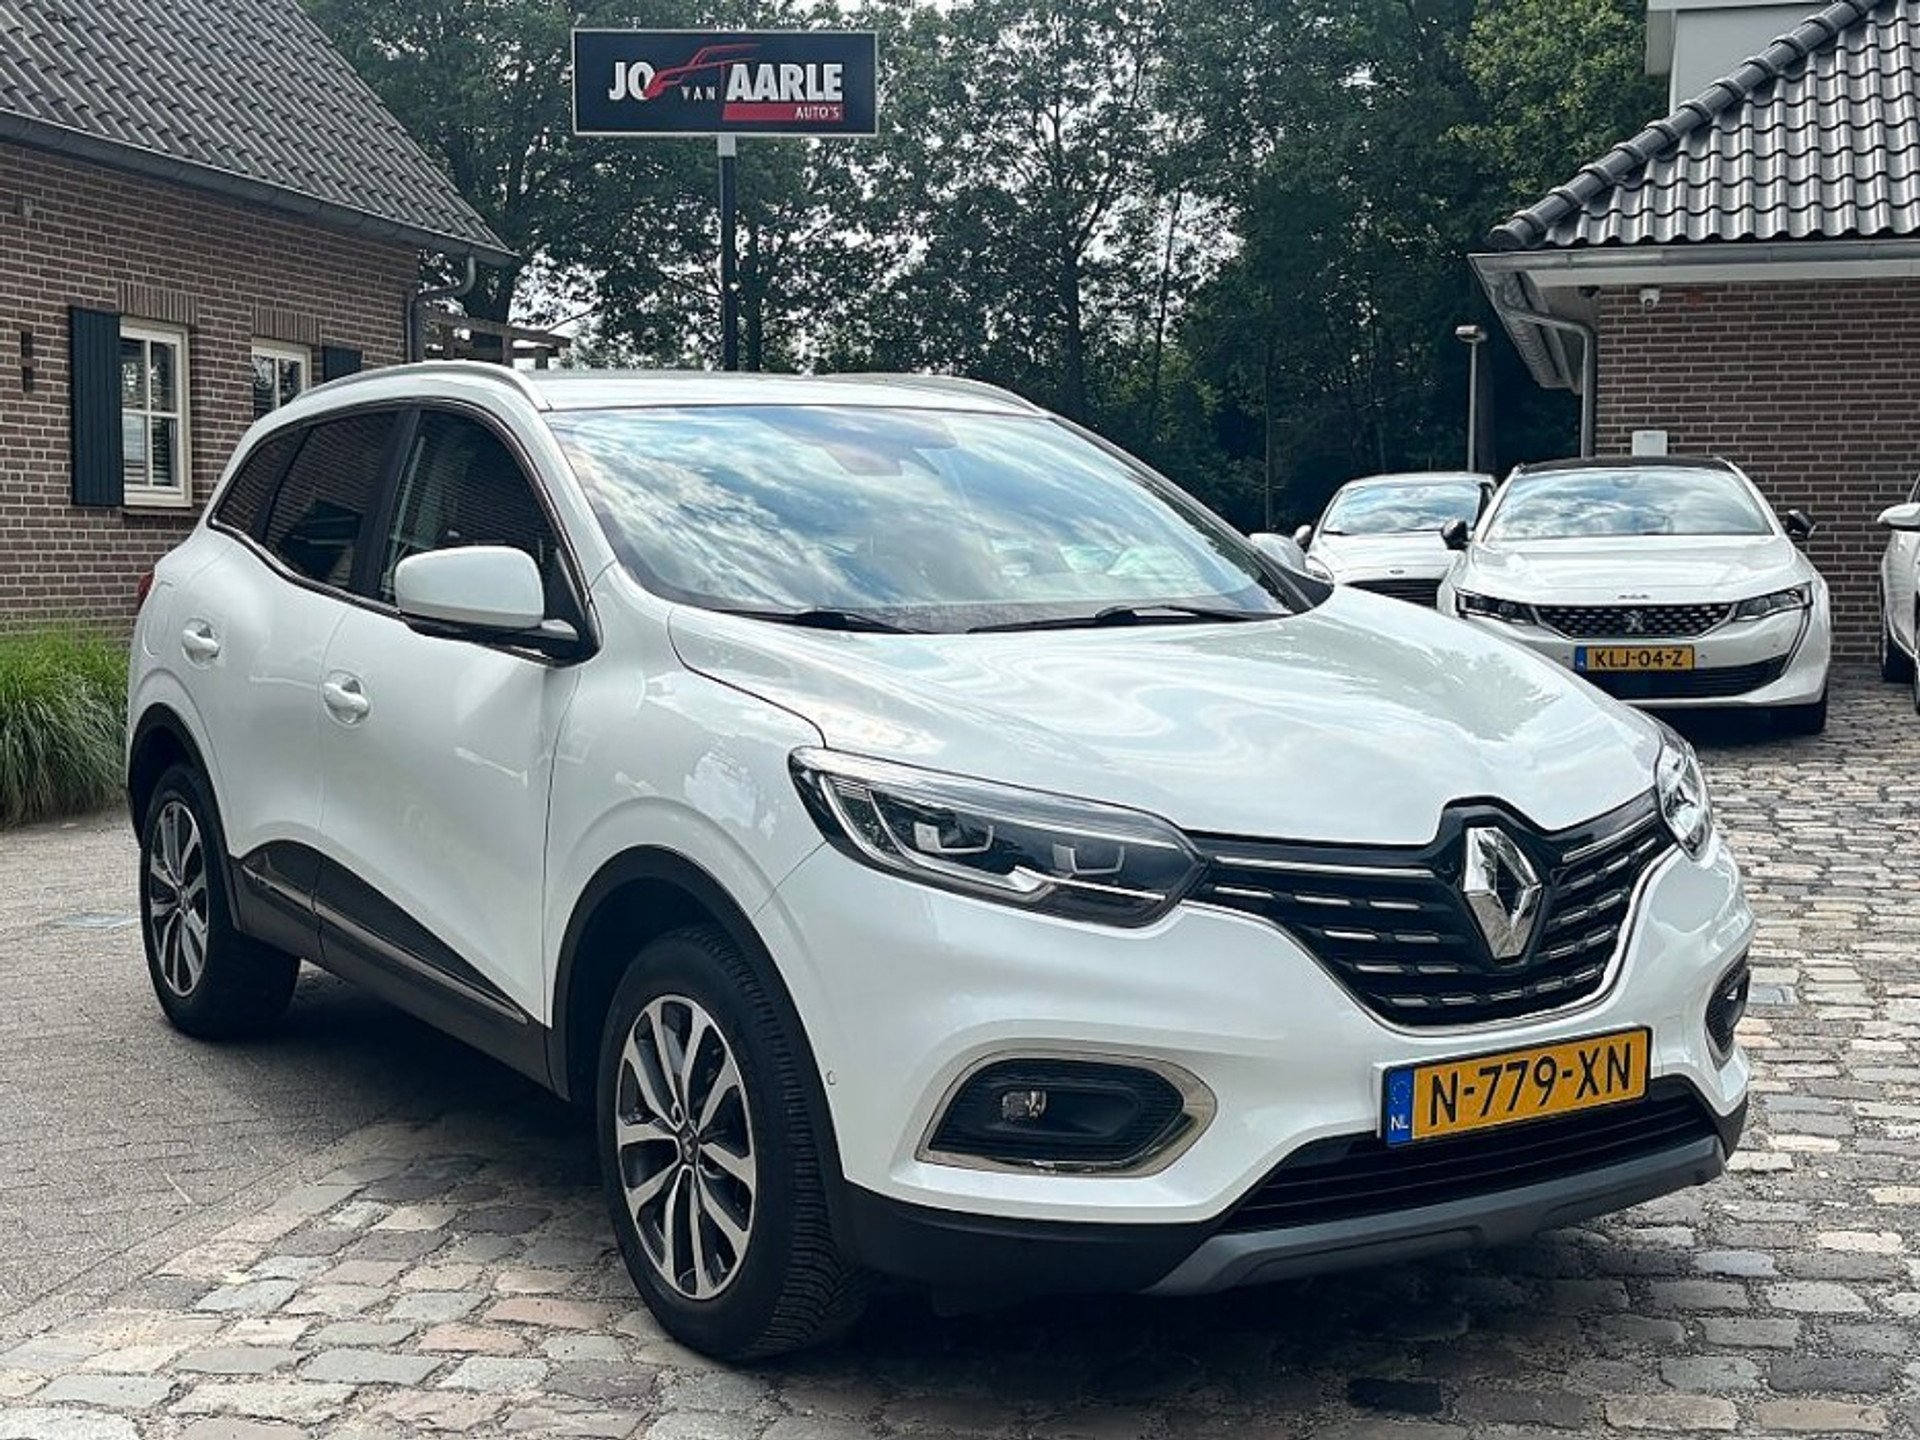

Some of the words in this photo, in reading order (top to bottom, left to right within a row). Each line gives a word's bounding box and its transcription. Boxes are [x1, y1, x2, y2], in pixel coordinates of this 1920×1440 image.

[609, 61, 656, 100] JO
[681, 86, 715, 100] VAN
[726, 63, 843, 101] AARLE
[795, 106, 840, 120] AUTO'S
[1594, 650, 1683, 668] KLJ-04-Z
[1430, 1042, 1632, 1126] N-779-XN
[1391, 1114, 1409, 1131] NL
